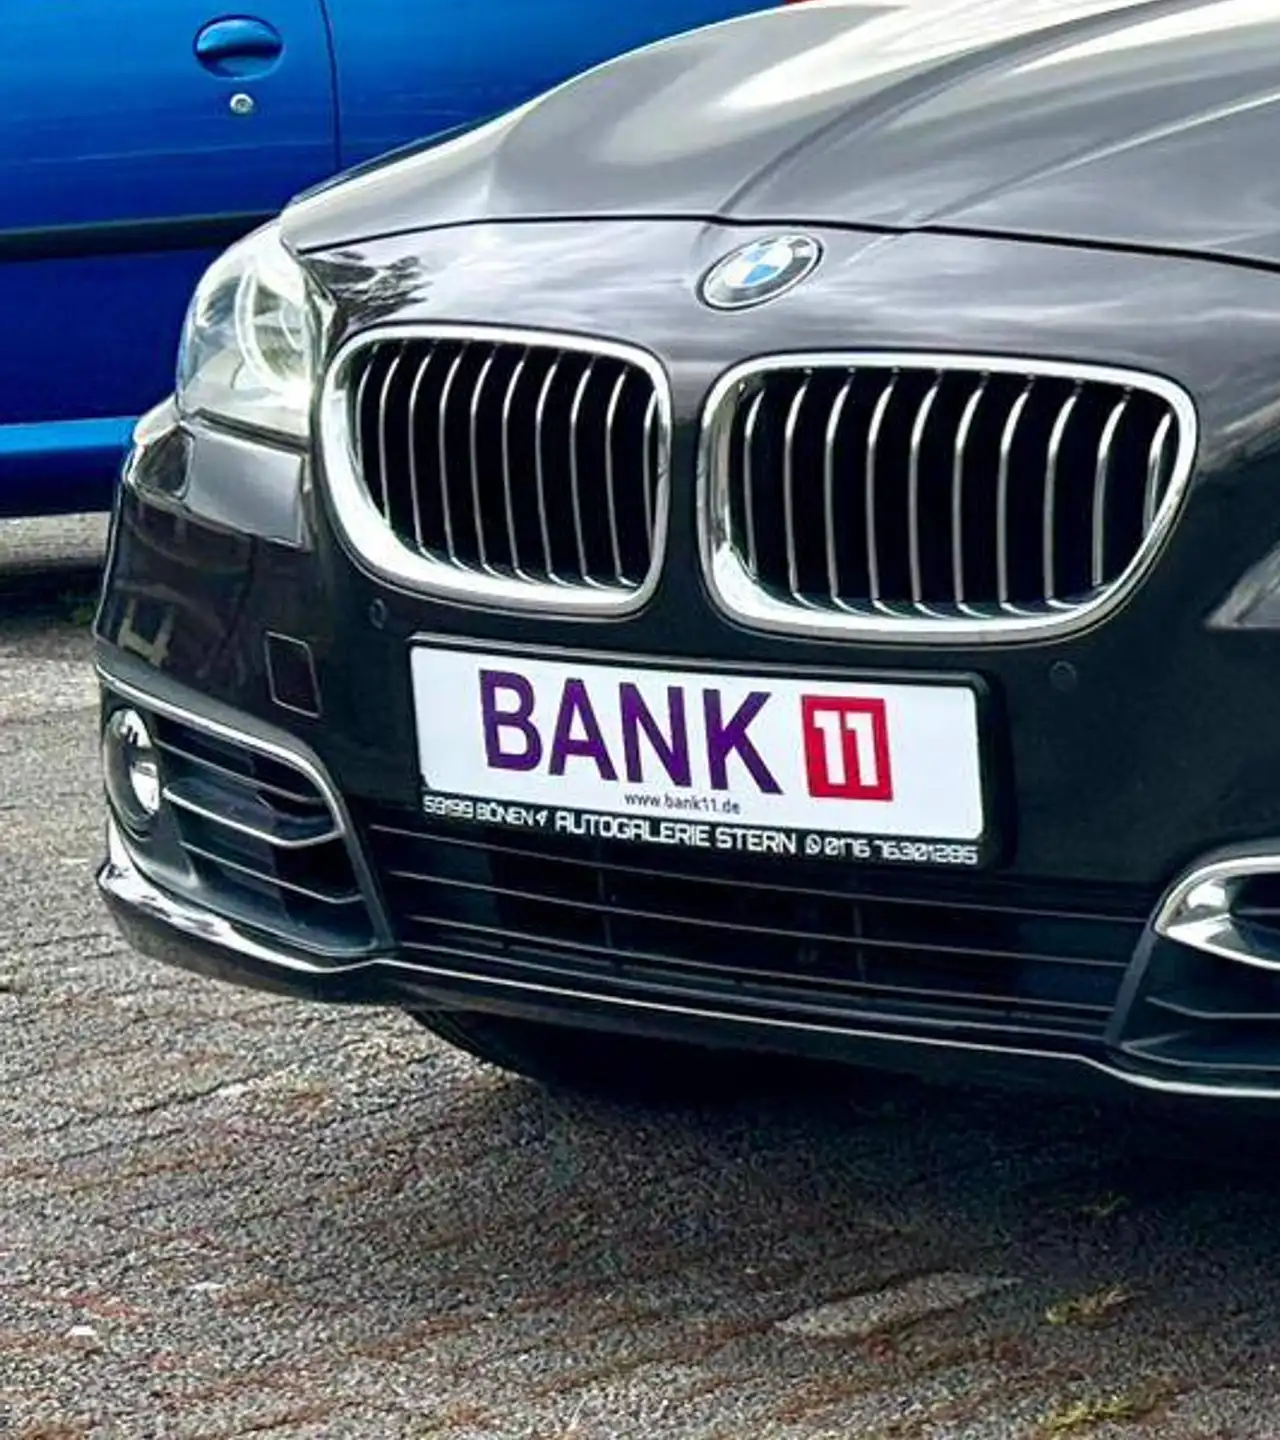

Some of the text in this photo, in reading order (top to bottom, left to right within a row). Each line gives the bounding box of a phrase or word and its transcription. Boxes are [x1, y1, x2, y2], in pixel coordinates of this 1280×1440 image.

[478, 668, 880, 796] BANK 11
[623, 792, 742, 815] www.bank11.de
[555, 810, 711, 848] AUTOGALERIE
[715, 826, 797, 854] STERN
